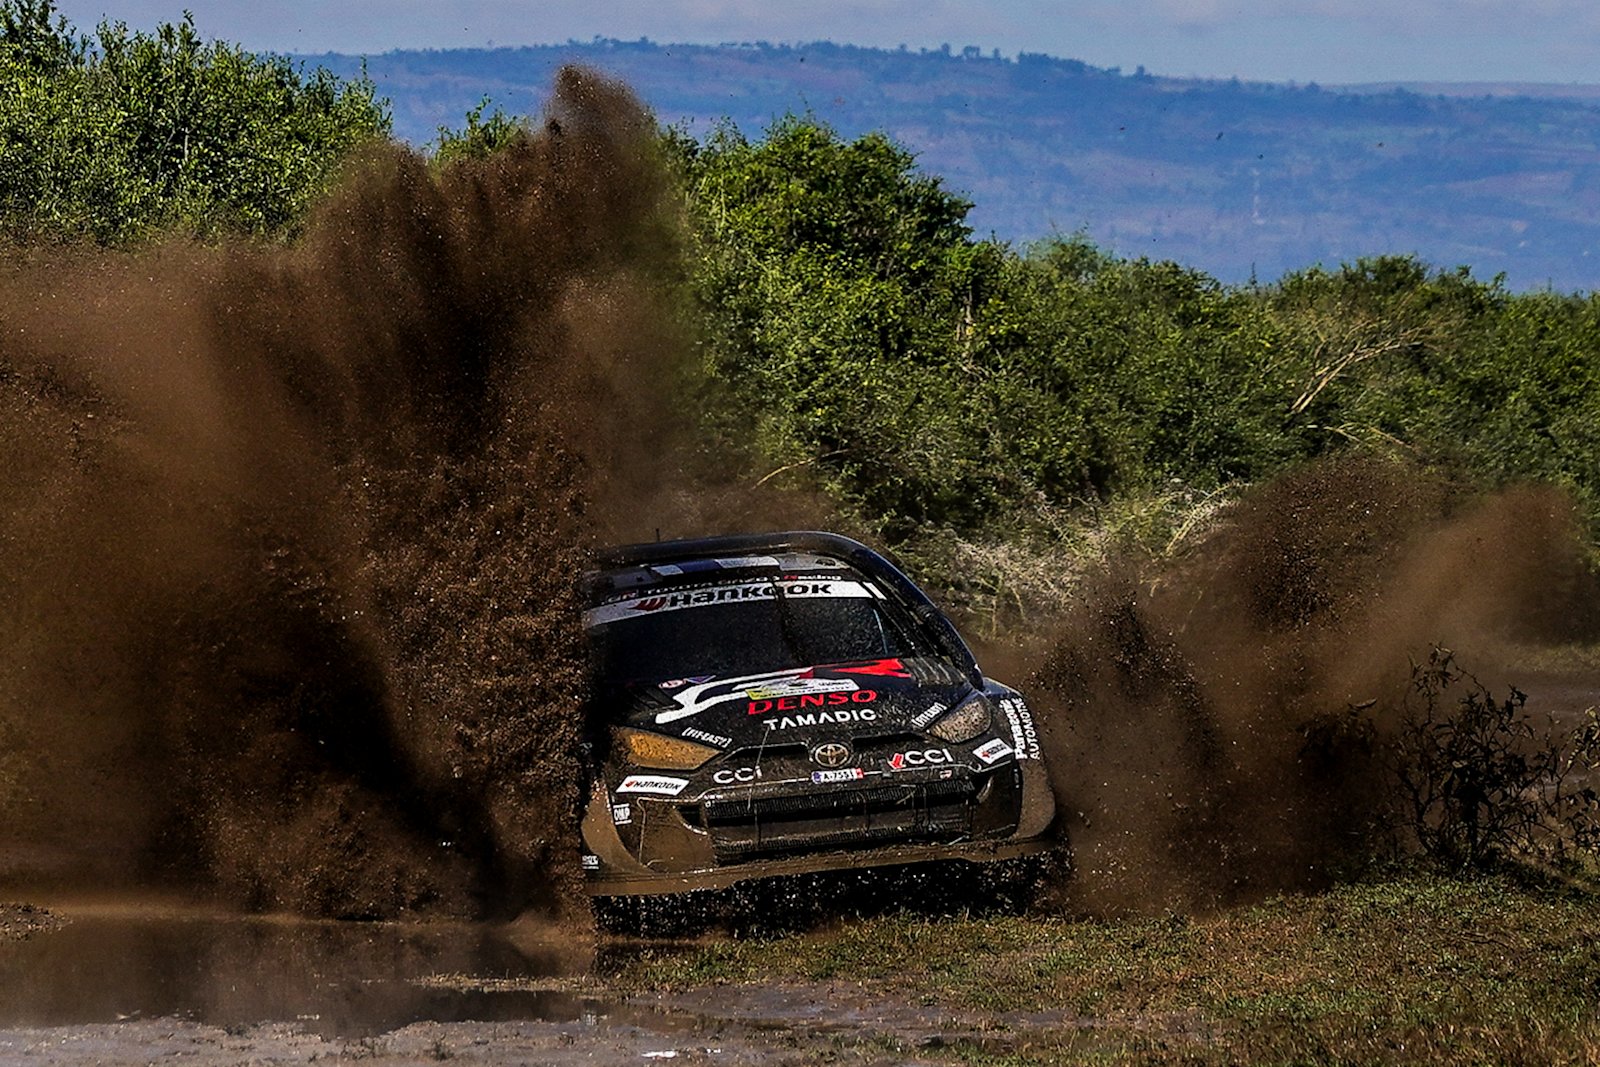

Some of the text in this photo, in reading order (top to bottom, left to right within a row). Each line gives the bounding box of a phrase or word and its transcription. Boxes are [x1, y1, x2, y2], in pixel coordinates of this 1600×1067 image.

[748, 690, 877, 715] DENSO
[763, 708, 878, 731] TAMADIC
[904, 748, 954, 765] CCI
[713, 765, 762, 784] CCI
